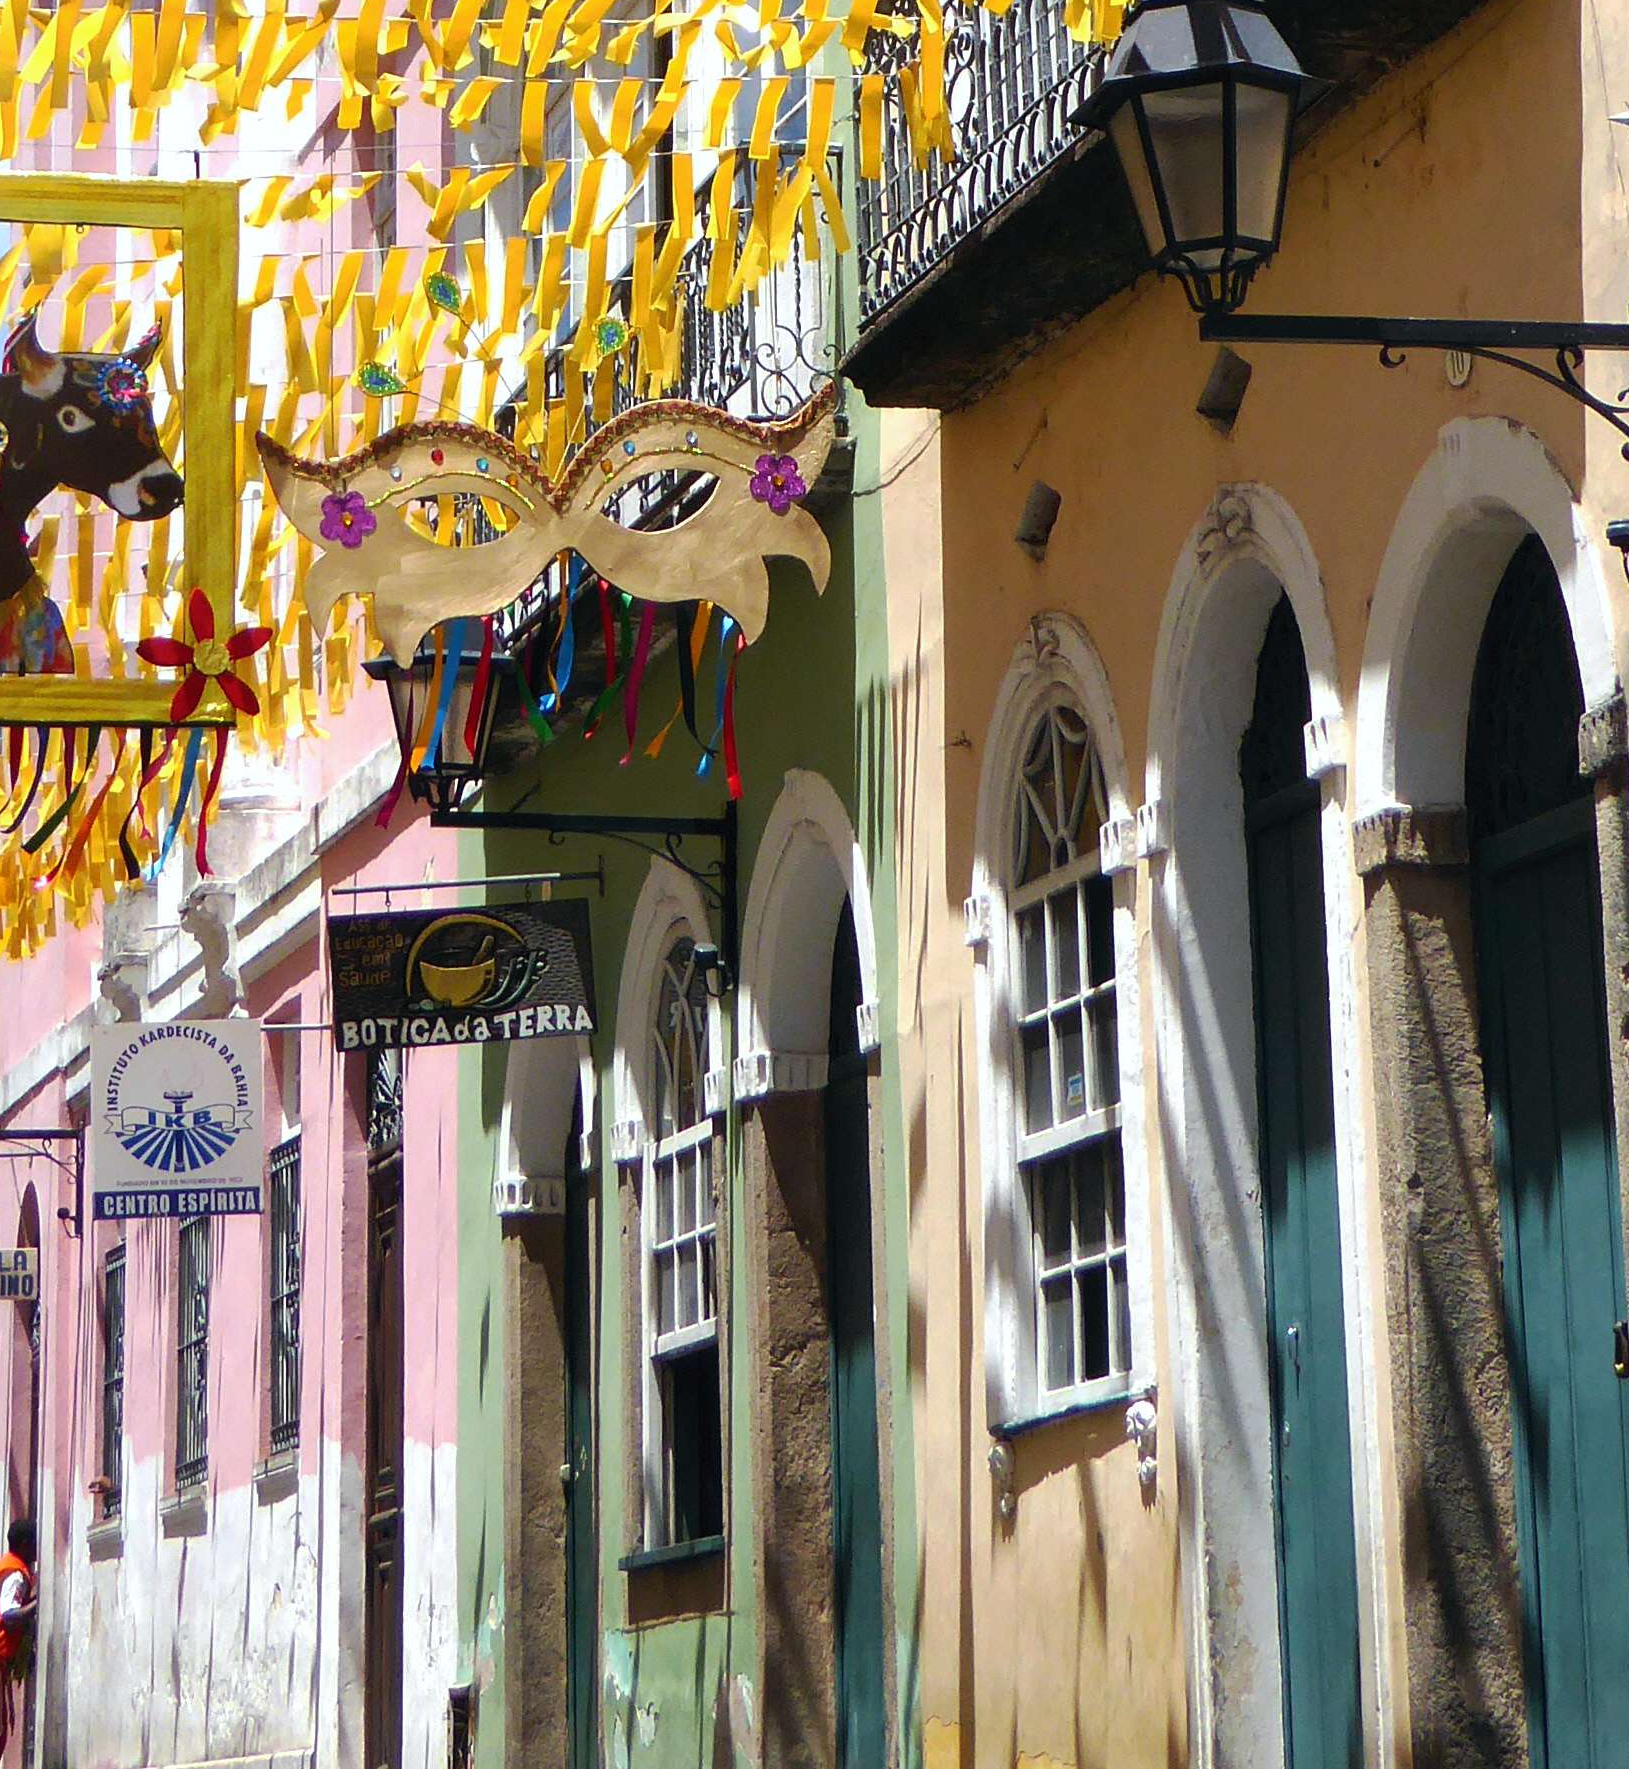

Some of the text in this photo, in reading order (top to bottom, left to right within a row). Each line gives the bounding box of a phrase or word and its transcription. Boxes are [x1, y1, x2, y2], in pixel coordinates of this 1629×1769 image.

[493, 1004, 594, 1039] TERRA
[106, 1025, 249, 1112] INSTITUTO KARDECISTA DA BAHIA
[103, 1188, 256, 1216] CENTRO ESPÍRITA
